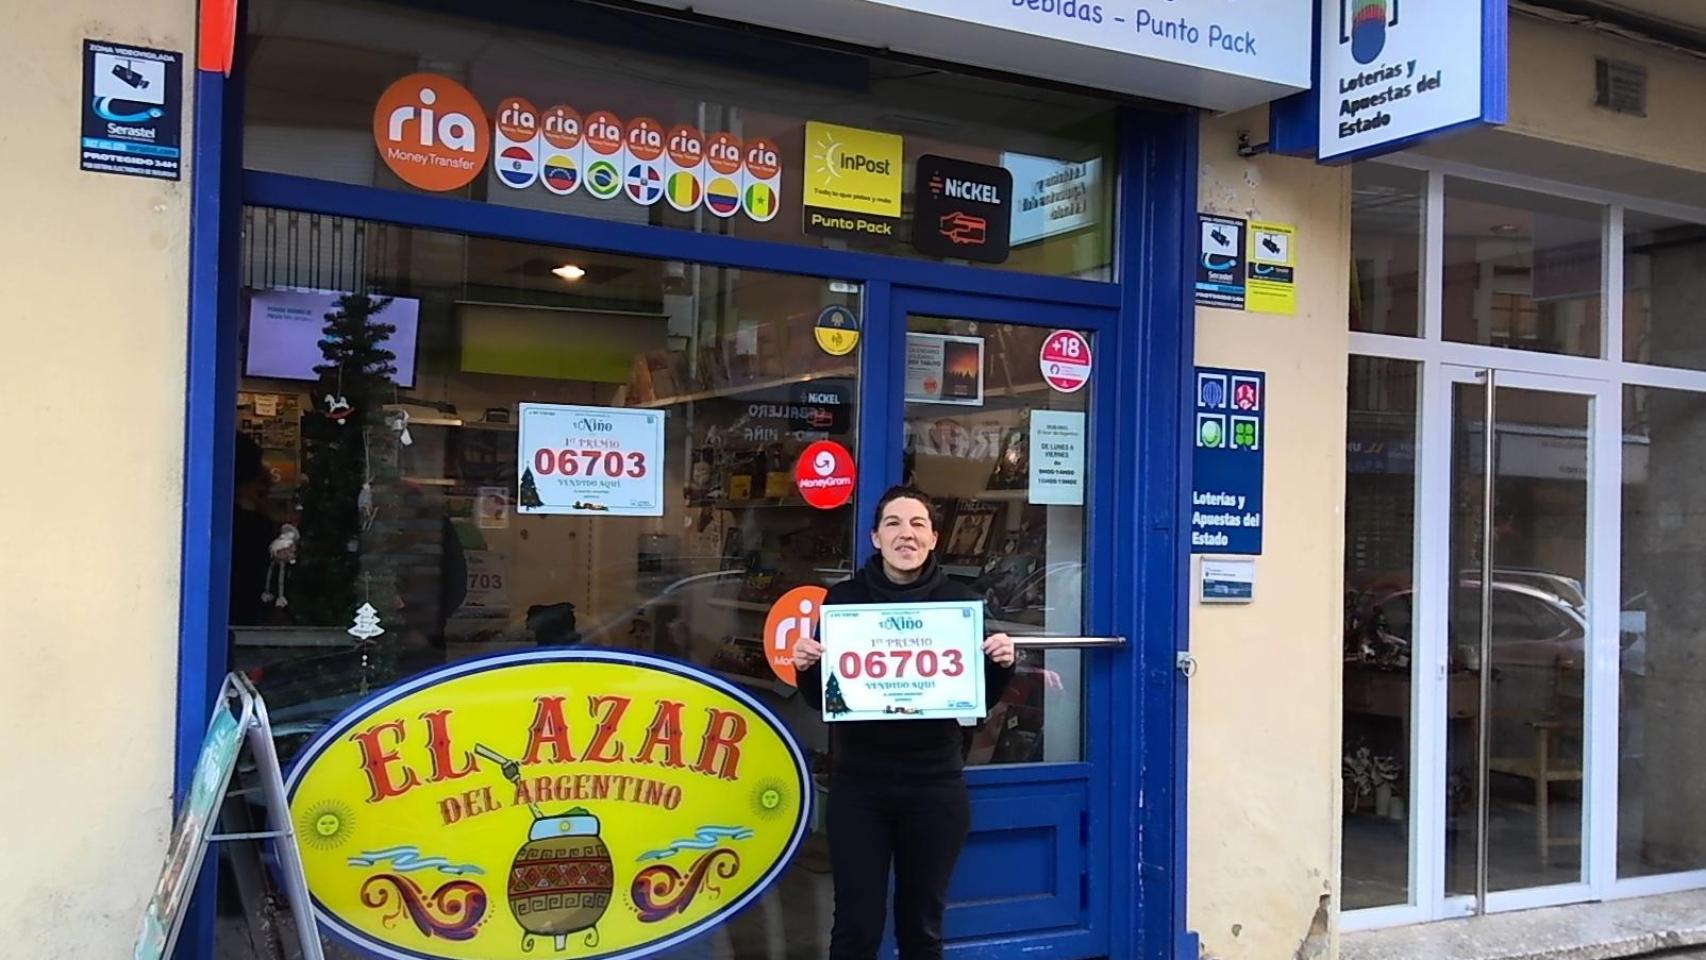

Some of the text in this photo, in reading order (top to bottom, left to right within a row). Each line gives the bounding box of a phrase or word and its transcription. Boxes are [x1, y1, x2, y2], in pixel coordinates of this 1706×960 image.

[1136, 9, 1200, 45] Punto
[1208, 24, 1257, 56] Pack
[1339, 59, 1416, 94] Loterías y
[1339, 70, 1442, 117] Apuestas del
[388, 87, 476, 154] ria
[501, 102, 534, 128] ria
[546, 109, 578, 135] ria
[1338, 110, 1391, 138] Estado
[107, 122, 156, 138] Serastel
[588, 116, 620, 141] ria
[630, 122, 661, 147] ria
[670, 130, 702, 155] ria
[710, 137, 740, 161] ria
[748, 142, 777, 166] ria
[387, 147, 475, 171] Money Transfer
[841, 152, 890, 176] InPost
[811, 214, 892, 235] Punto Pack
[1052, 336, 1080, 358] +18
[584, 417, 613, 432] Niño
[579, 438, 620, 449] PREMIO
[534, 448, 646, 478] 06703
[799, 474, 852, 490] MoneyGram
[1193, 490, 1245, 510] Loterías y
[1192, 511, 1260, 529] Apuestas del
[1192, 532, 1229, 546] Estado
[468, 574, 503, 589] 703
[775, 599, 817, 650] ri
[891, 616, 924, 631] Niño
[886, 638, 933, 648] PREMIO
[839, 649, 964, 679] 06703
[865, 681, 910, 690] VENDIDO
[349, 695, 749, 804] EL AZAR
[437, 773, 683, 825] DEL ARGENTINO
